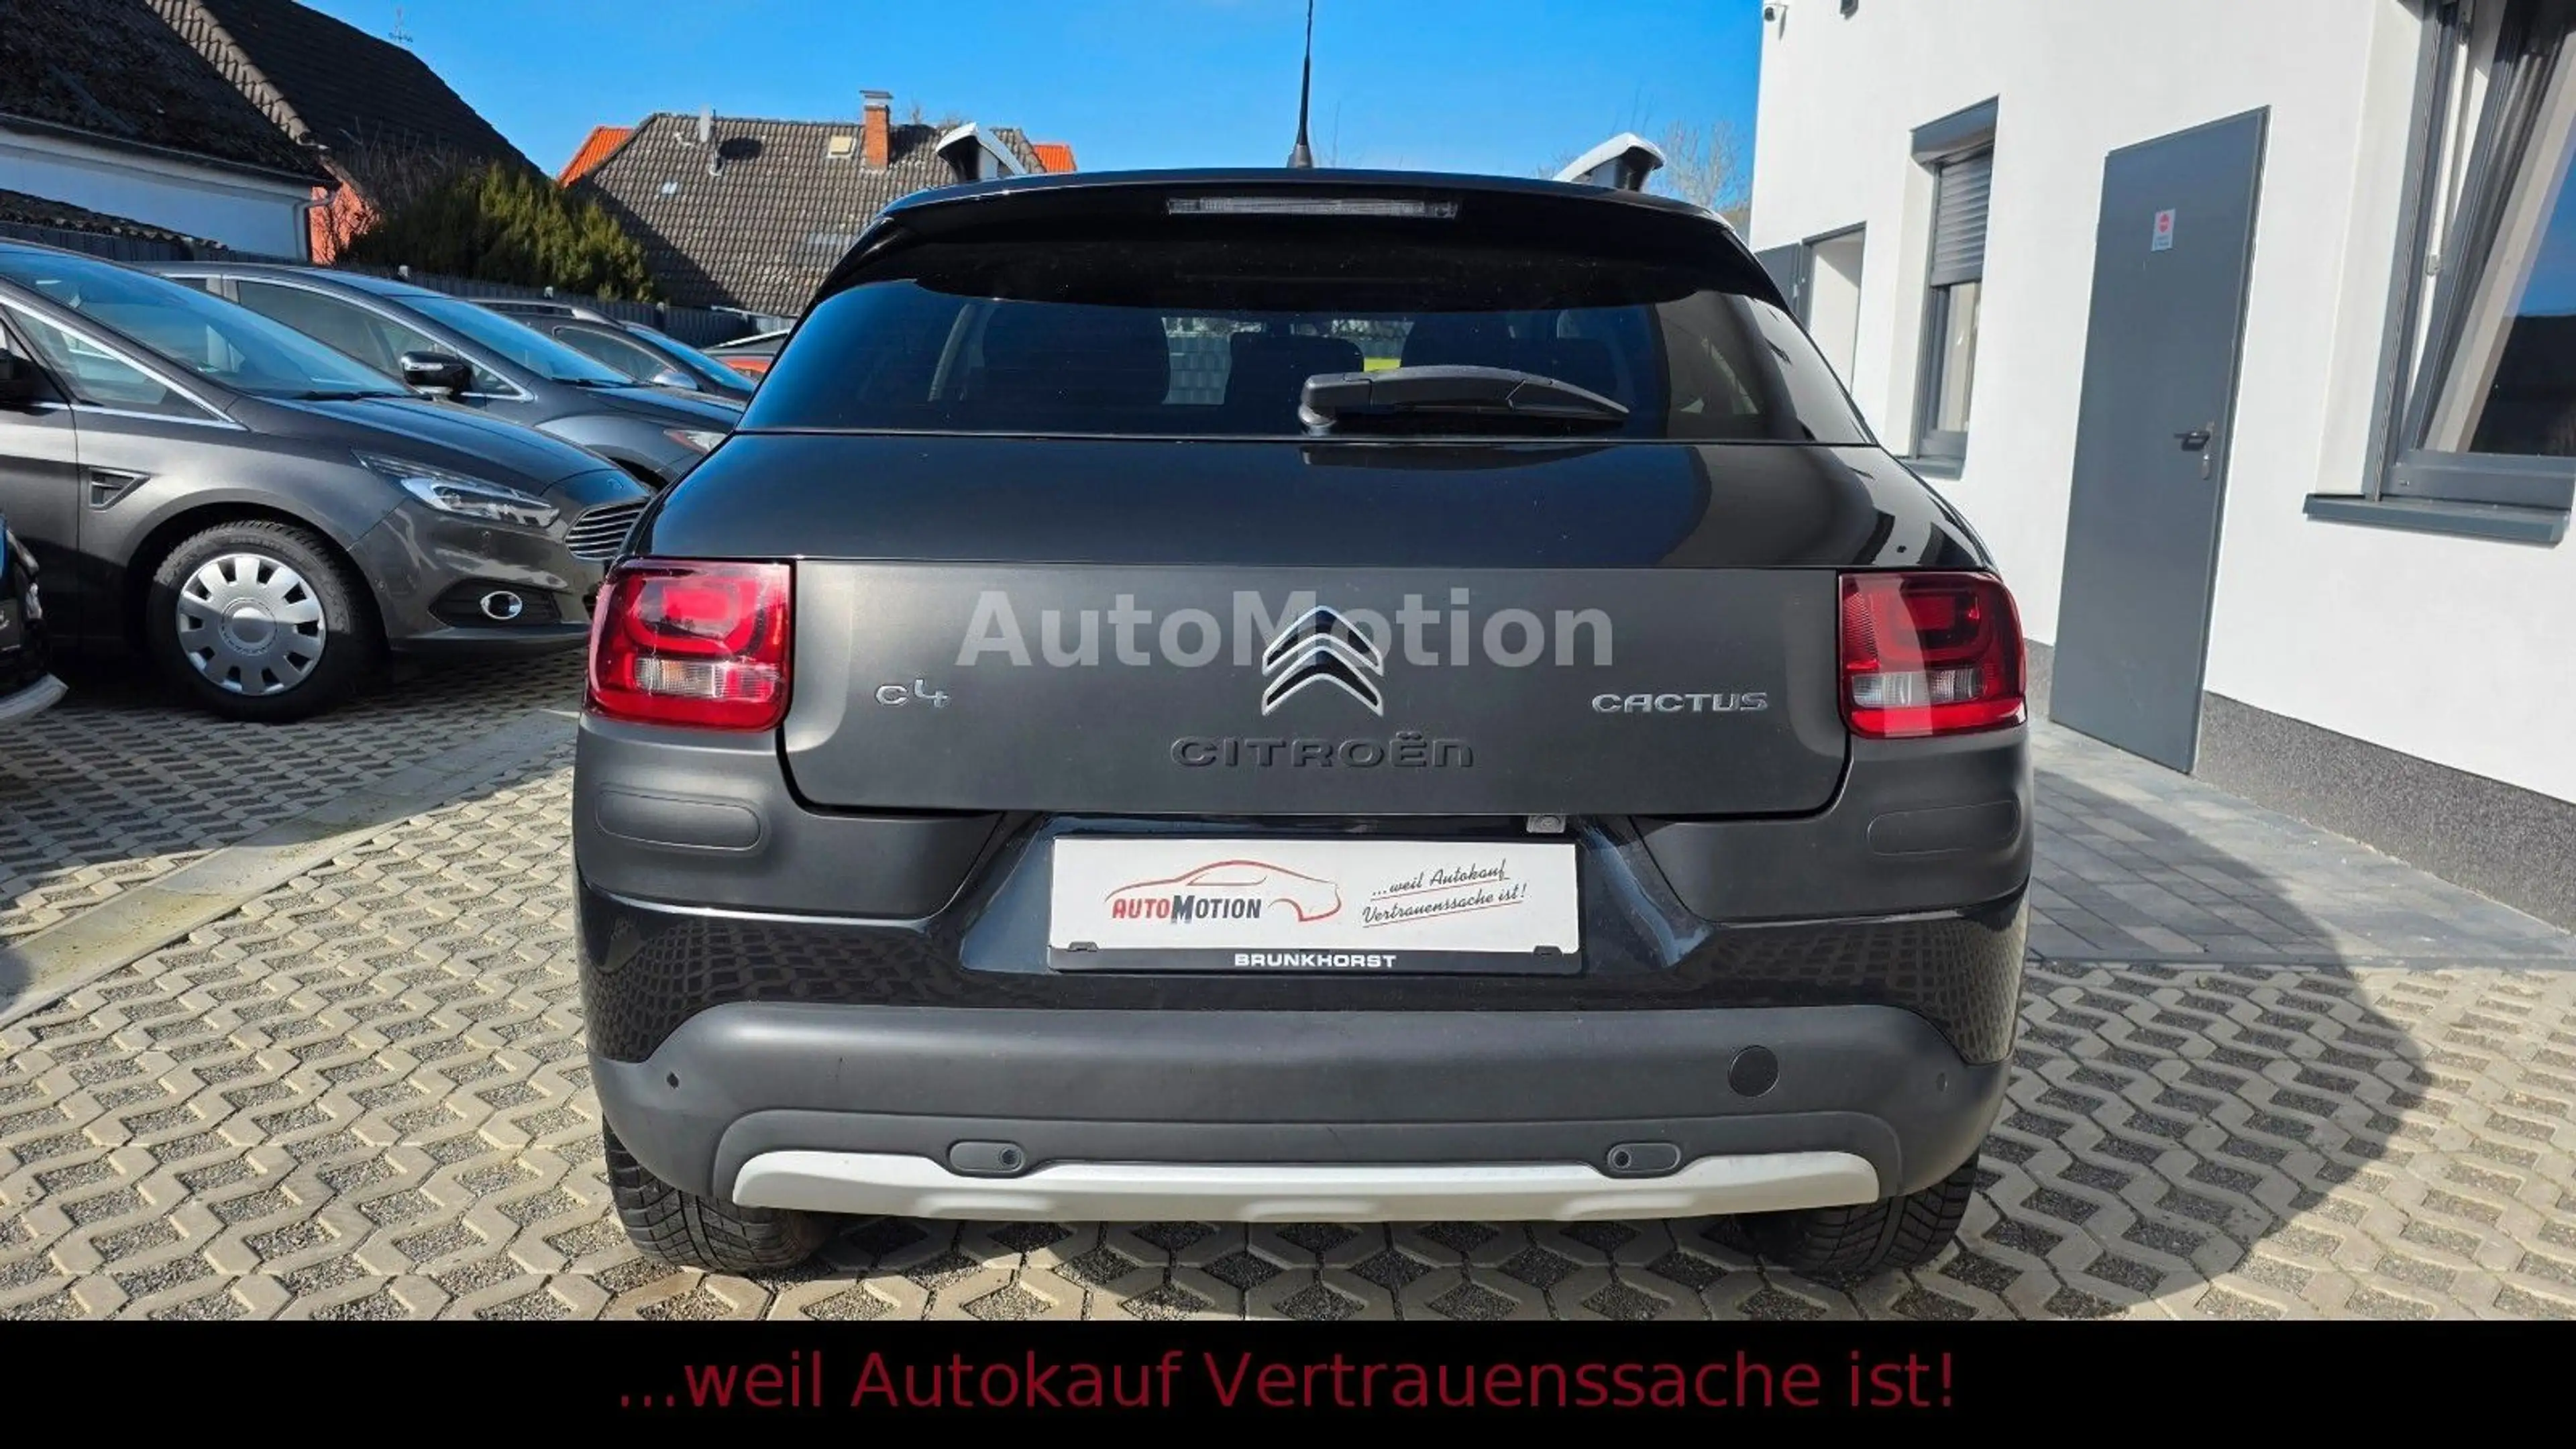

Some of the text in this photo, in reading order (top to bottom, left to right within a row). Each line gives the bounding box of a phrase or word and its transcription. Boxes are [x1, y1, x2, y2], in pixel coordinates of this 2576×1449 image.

[875, 678, 949, 707] C4
[1591, 692, 1768, 712] CACTUS
[1429, 858, 1509, 885] Autokauf
[1362, 883, 1527, 924] Vertrauenssache ist!
[1234, 953, 1397, 967] BRUNKHORST
